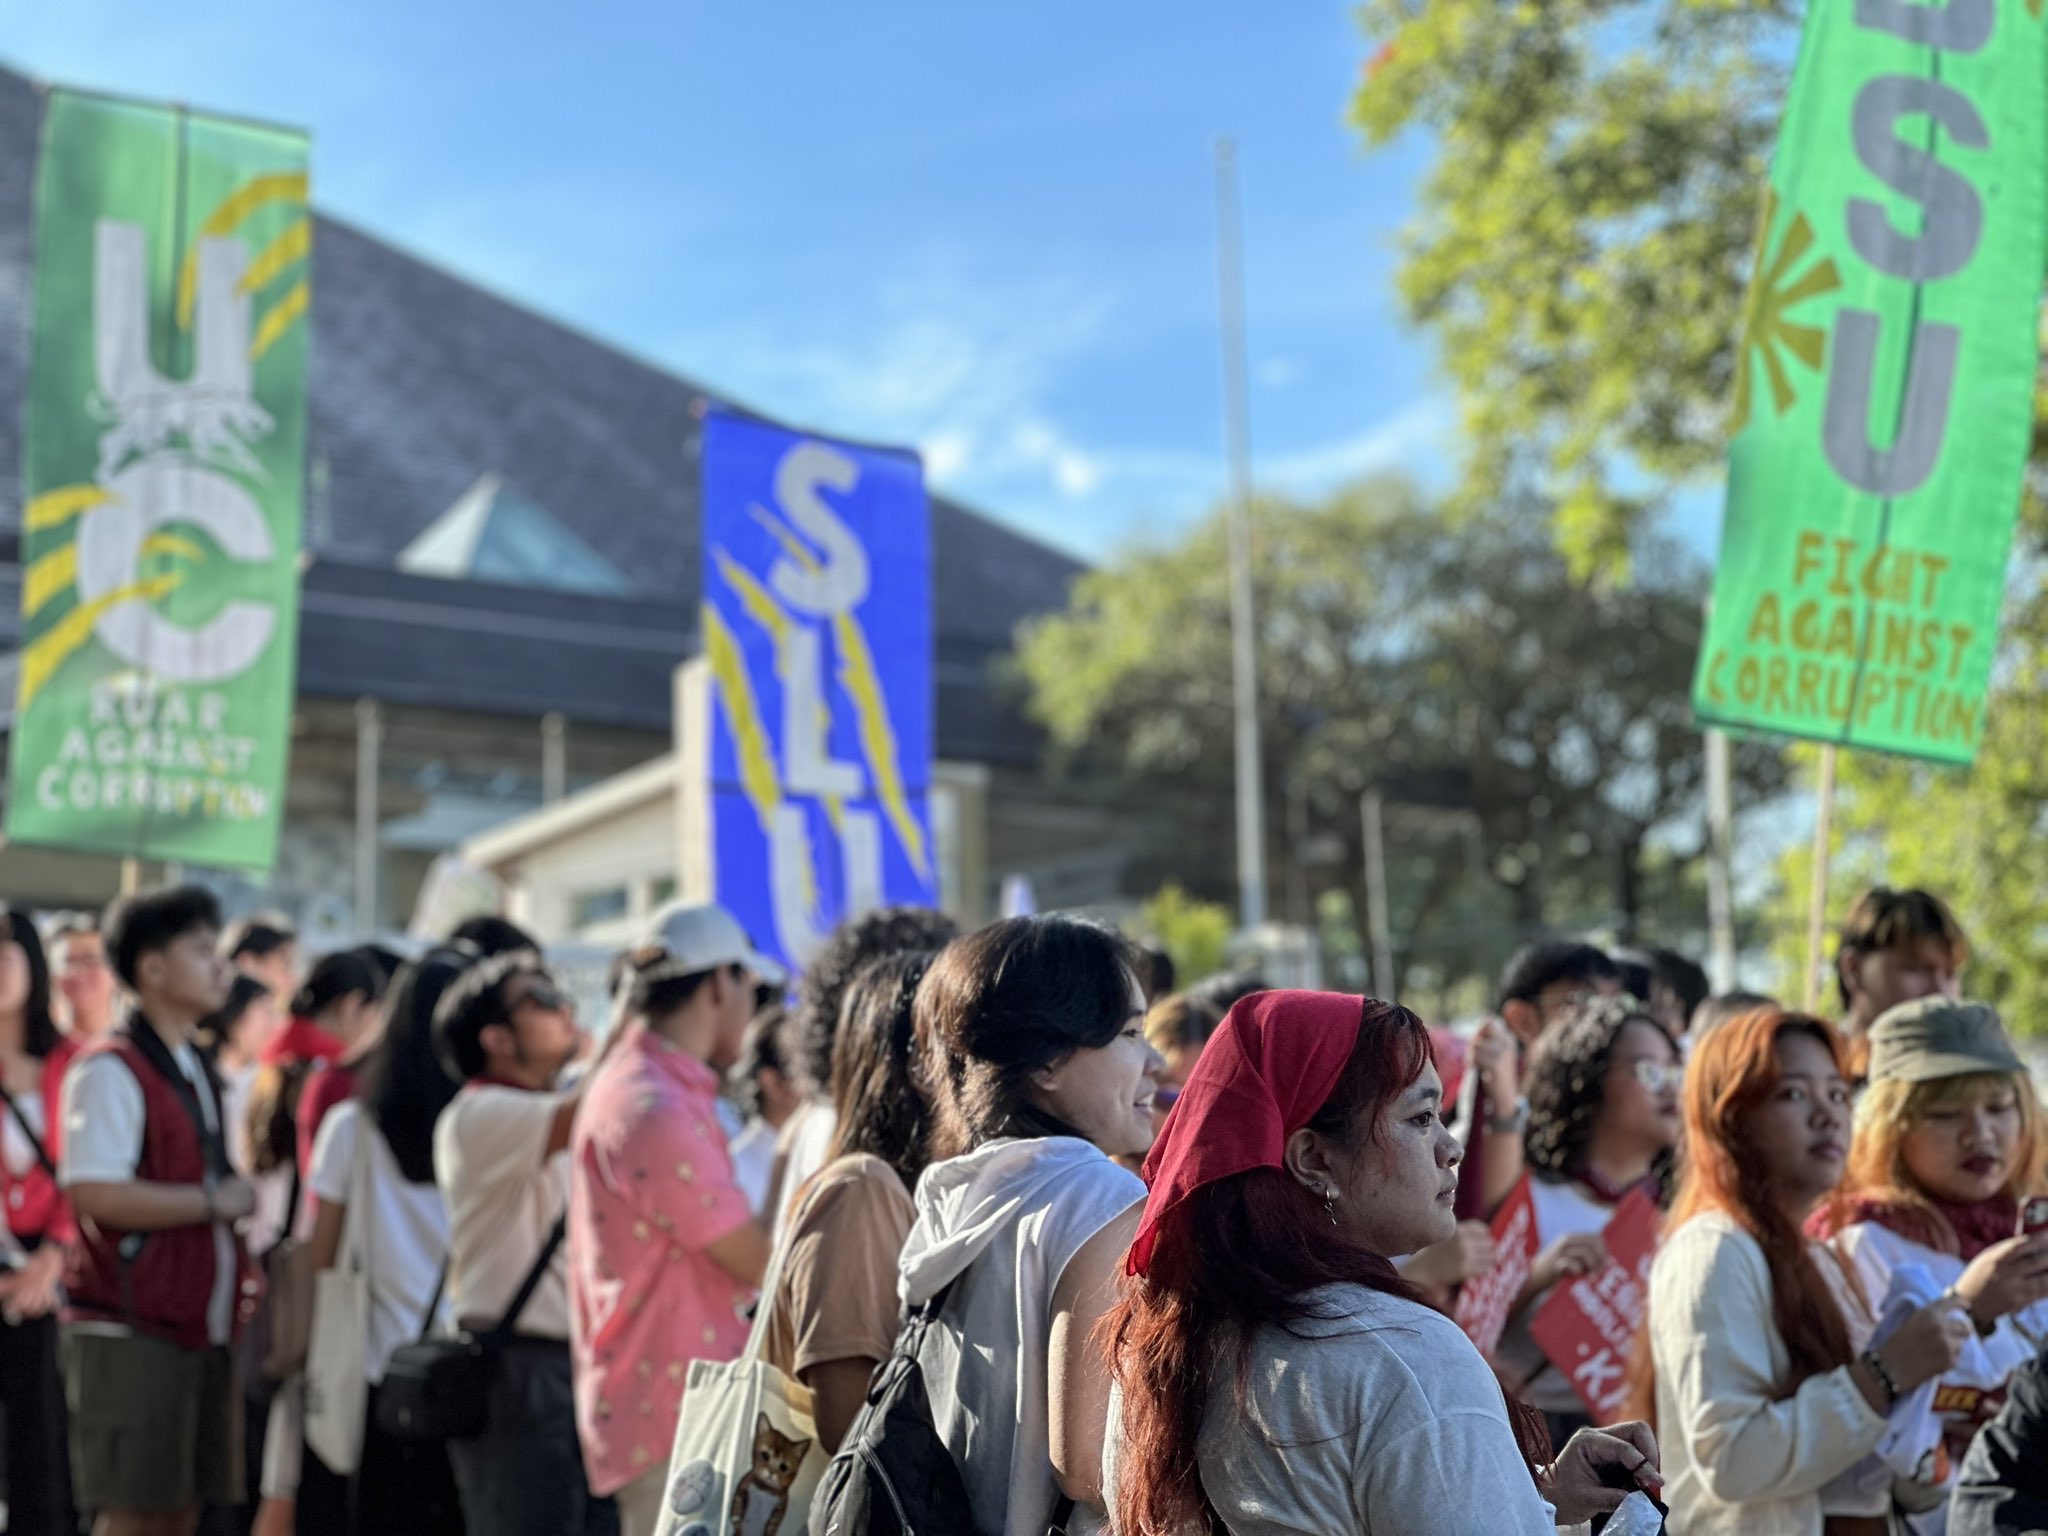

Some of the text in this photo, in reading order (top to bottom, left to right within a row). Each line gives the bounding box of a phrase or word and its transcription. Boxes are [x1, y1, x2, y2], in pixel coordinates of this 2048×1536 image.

[1793, 530, 1948, 610] FIGHT
[1746, 591, 1974, 680] AGAINST
[766, 438, 885, 972] SLU
[1704, 648, 1981, 745] CORRUPTION
[58, 725, 258, 775] AGAINST
